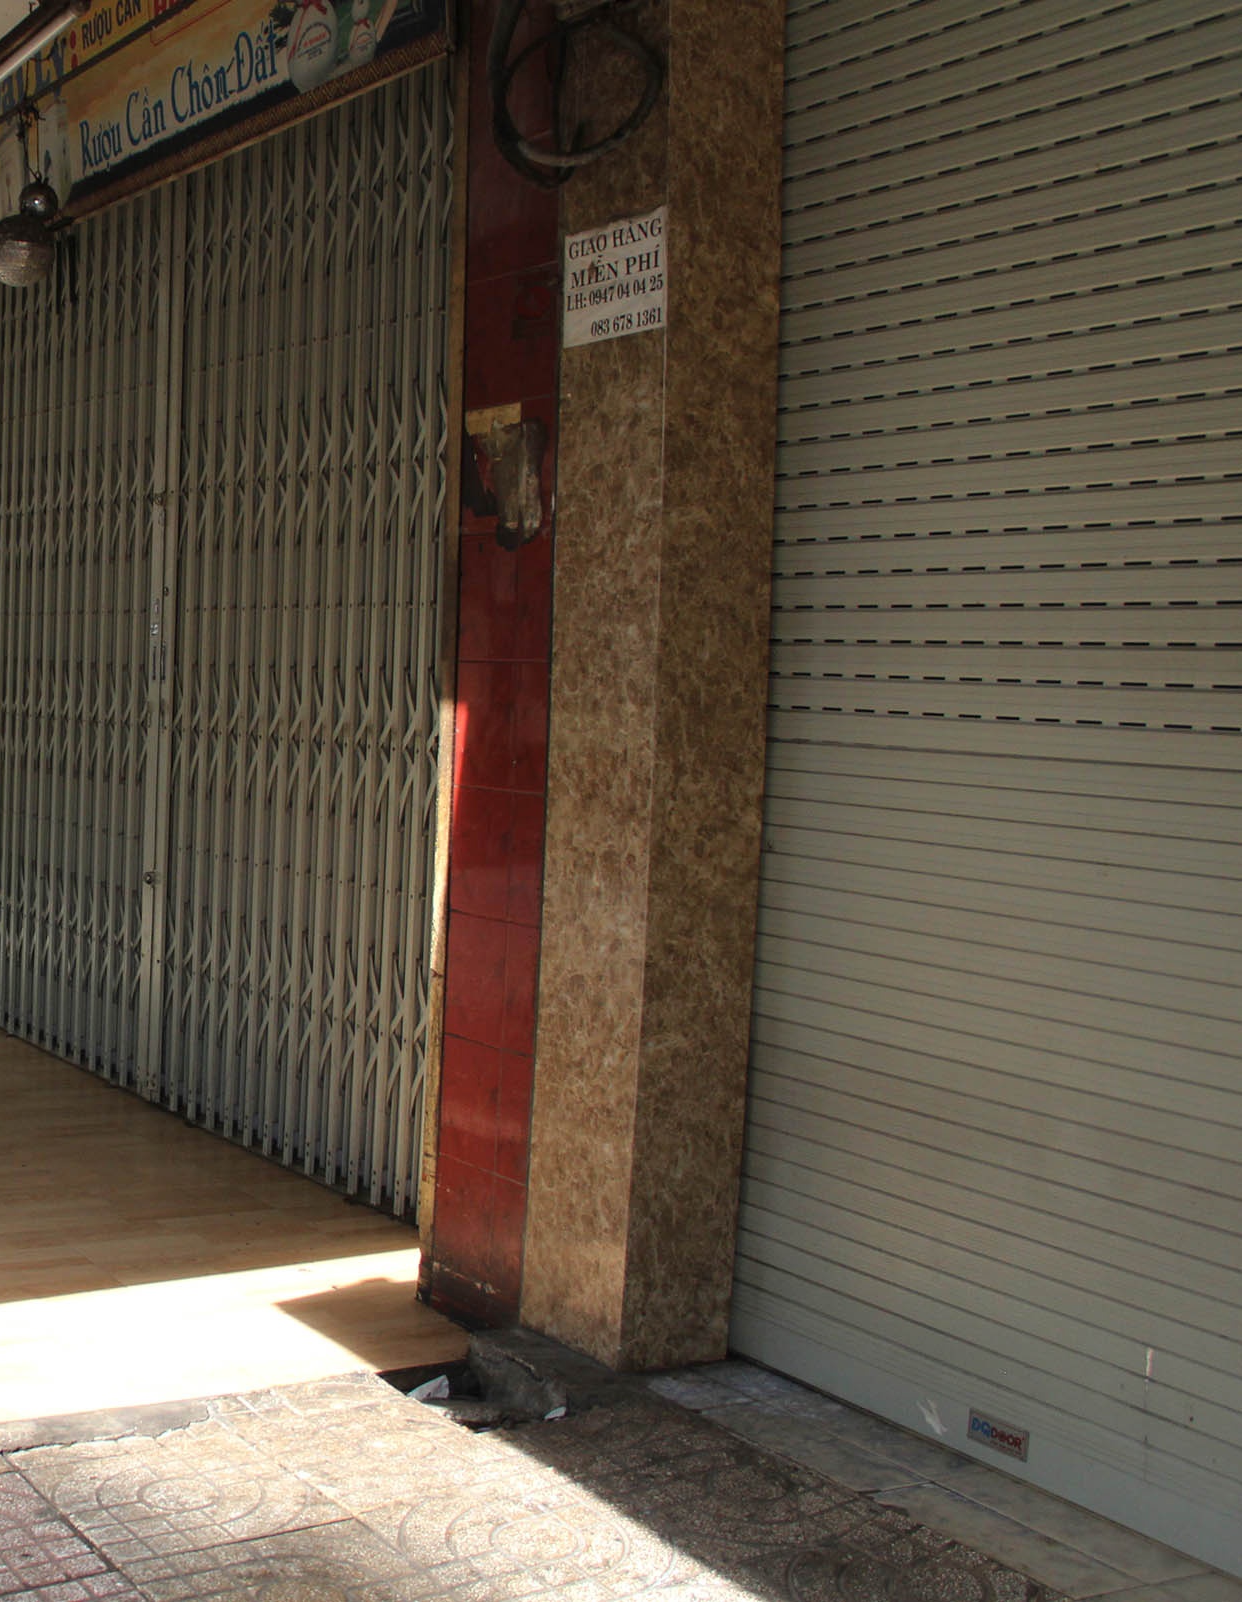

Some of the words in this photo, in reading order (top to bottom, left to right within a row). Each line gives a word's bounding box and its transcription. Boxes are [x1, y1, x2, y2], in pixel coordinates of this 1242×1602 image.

[80, 121, 122, 174] Rượu
[126, 87, 166, 145] Cần
[171, 61, 230, 122] Chôn
[569, 234, 607, 260] GIAO
[613, 218, 662, 248] HÀNG
[625, 244, 660, 276] PHÍ
[566, 295, 587, 312] LH:
[589, 285, 615, 306] 0947
[617, 284, 630, 299] 04
[633, 279, 646, 296] 04
[650, 273, 663, 292] 25
[591, 318, 610, 336] 083
[613, 313, 632, 332] 678
[636, 307, 662, 328] 1361
